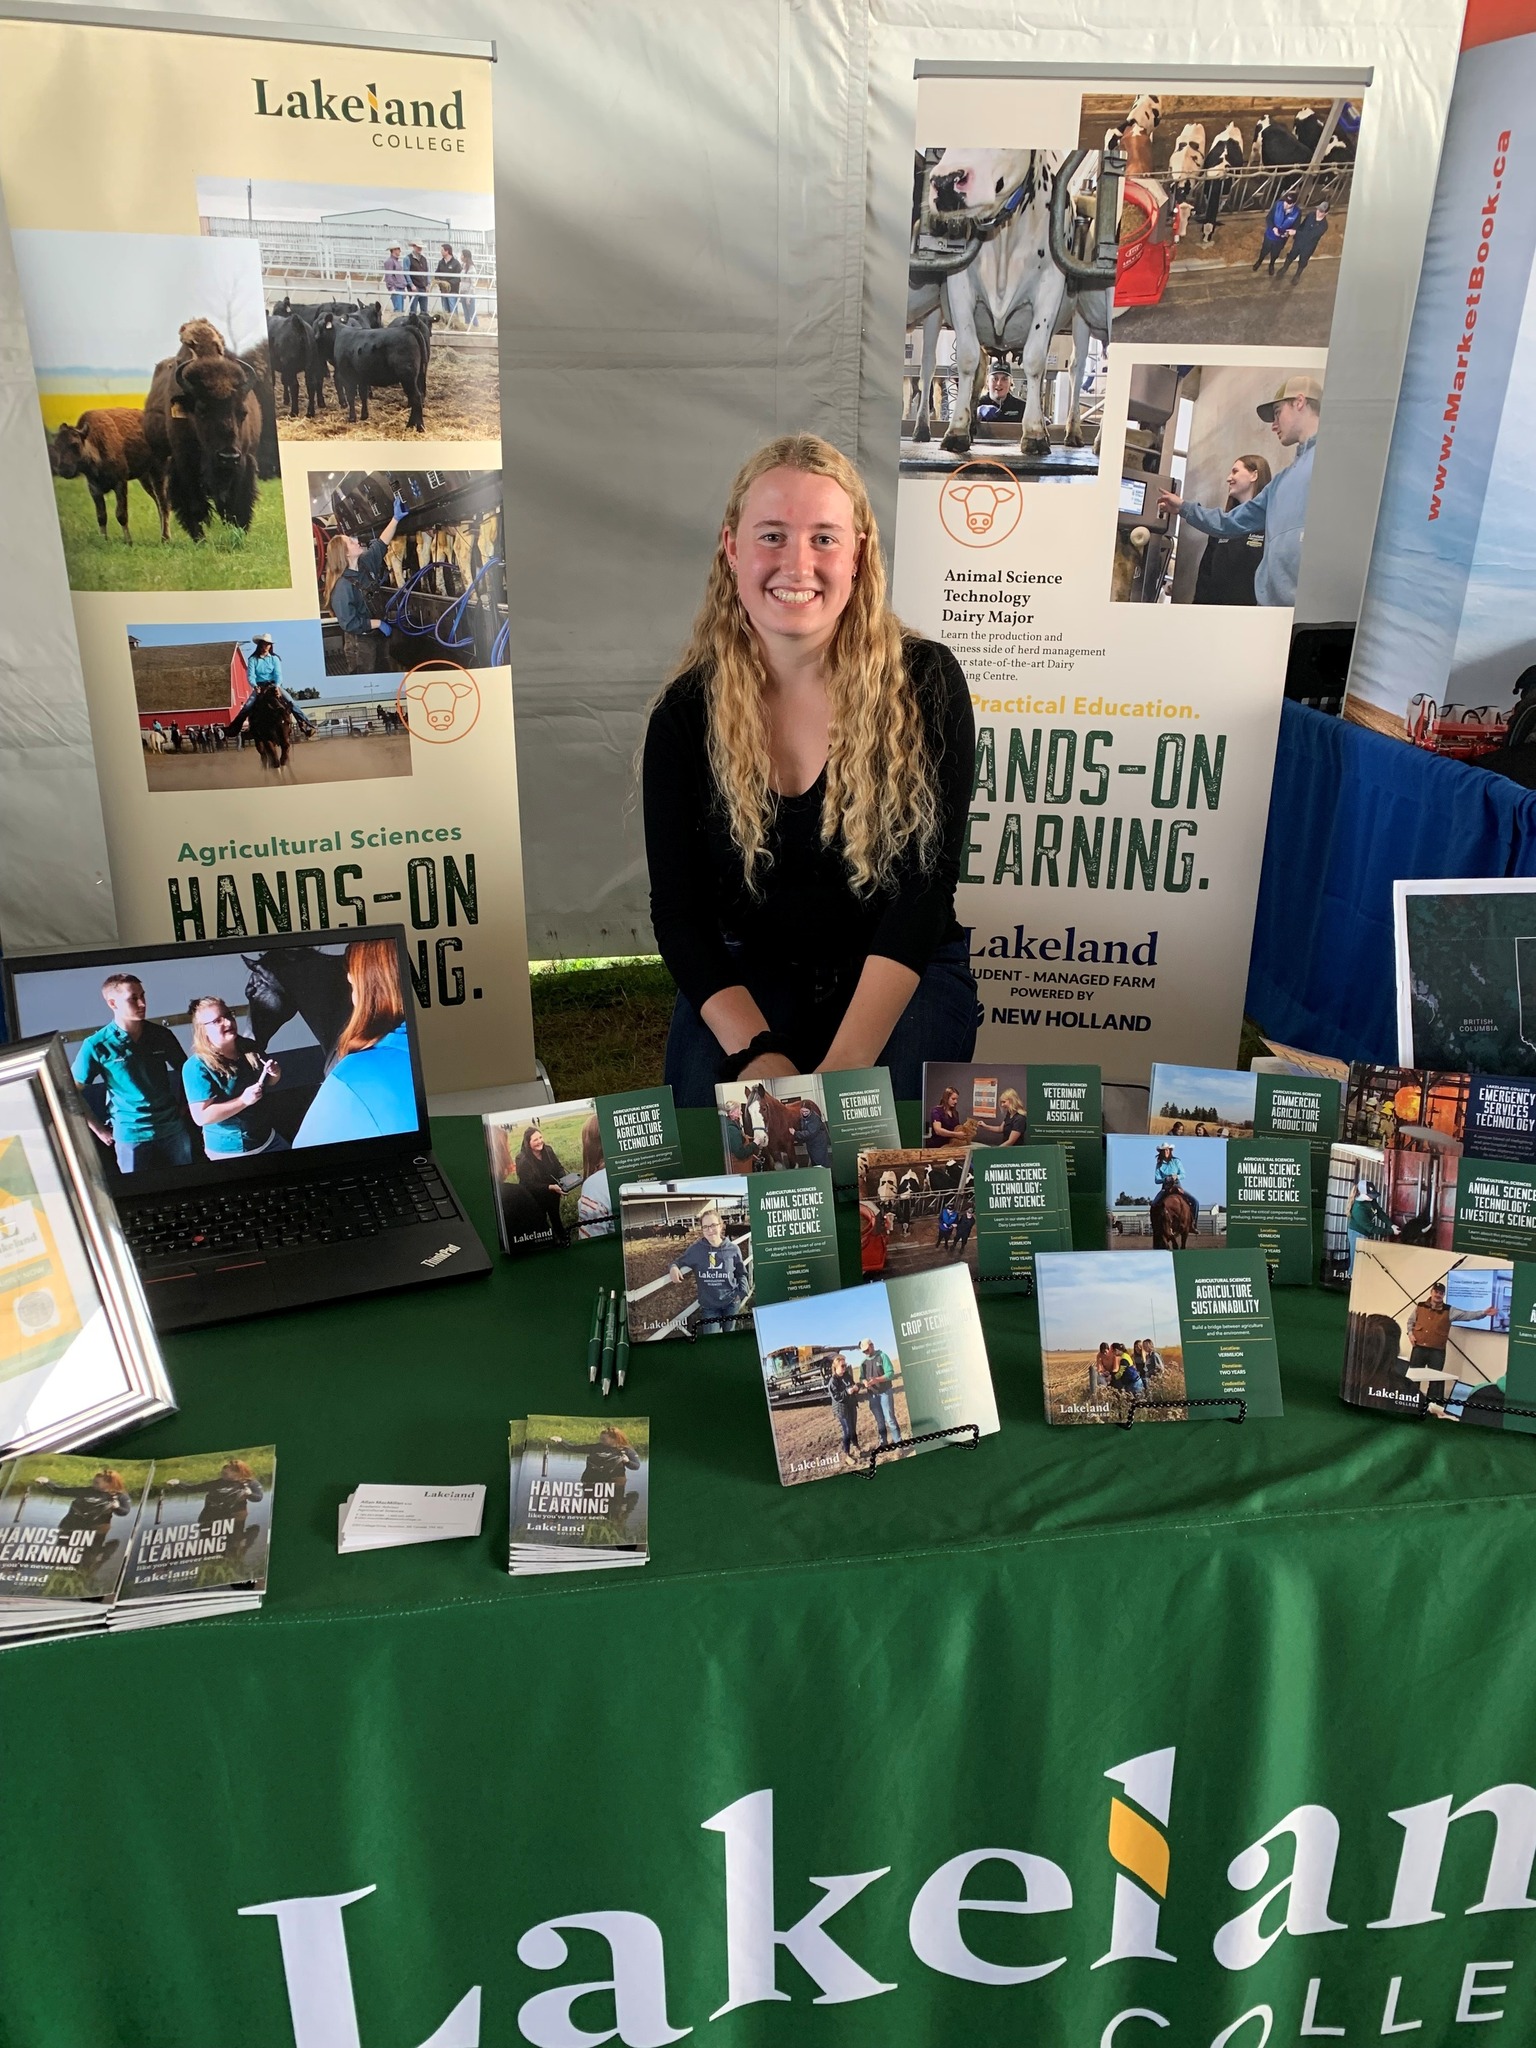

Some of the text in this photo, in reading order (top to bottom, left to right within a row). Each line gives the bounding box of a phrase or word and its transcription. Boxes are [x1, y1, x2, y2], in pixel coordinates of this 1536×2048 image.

[251, 78, 467, 131] Lakeland
[371, 133, 466, 154] COLLEGE
[1428, 129, 1512, 523] www.MarketBook.ca
[944, 569, 1062, 585] Animal Science
[943, 588, 1031, 607] Technology
[942, 609, 1035, 628] Dairy Major
[940, 630, 1063, 643] Learn the production and
[948, 643, 1106, 660] siness side of herd management
[969, 658, 1045, 669] state-of-the-art
[1047, 659, 1074, 671] Dairy
[983, 671, 1018, 682] Centre.
[970, 693, 1200, 719] Practical Education.
[970, 727, 1227, 810] ANDS-ON
[177, 826, 462, 867] Agricultural Sciences
[959, 812, 1209, 893] EARNING.
[167, 853, 479, 942] HANDS-ON
[963, 924, 1158, 967] Lakeland
[969, 968, 1023, 982] UDENT
[1033, 970, 1110, 986] MANAGED
[1112, 972, 1156, 989] FARM
[1010, 986, 1095, 1001] POWERED BY
[991, 1007, 1152, 1032] NEW HOLLAND
[1459, 1024, 1499, 1032] COLUMBIA
[840, 1094, 880, 1109] VETERINARY
[1043, 1088, 1086, 1099] VETERINARY
[1272, 1094, 1320, 1109] COMMERCIAL
[1479, 1087, 1536, 1106] EMERGENCY
[842, 1106, 882, 1121] TECHNOLOGY
[1050, 1099, 1080, 1110] MEDICAL
[1271, 1106, 1320, 1121] AGRICULTURE
[1483, 1101, 1529, 1118] SERVICES
[613, 1108, 661, 1128] BACHELOR OF
[1046, 1111, 1084, 1122] ASSISTANT
[1272, 1118, 1317, 1133] PRODUCTION
[1476, 1113, 1535, 1132] TECHNOLOGY
[617, 1121, 663, 1140] AGRICULTURE
[618, 1133, 663, 1152] TECHNOLOGY
[984, 1168, 1048, 1182] ANIMAL SCIENCE
[1237, 1162, 1301, 1176] ANIMAL SCIENCE
[991, 1181, 1043, 1195] TECHNOLOGY:
[1243, 1176, 1295, 1188] TECHNOLOGY:
[1467, 1181, 1536, 1201] ANIMAL SCIENCE
[760, 1192, 824, 1211] ANIMAL SCIENCE
[765, 1188, 797, 1197] AGRICULTURAL
[1238, 1189, 1300, 1202] EQUINE SCIENCE
[989, 1195, 1046, 1209] DAIRY SCIENCE
[1474, 1195, 1531, 1214] TECHNOLOGY:
[767, 1206, 819, 1224] TECHNOLOGY:
[1459, 1208, 1536, 1230] LIVESTOCK SCIENC
[513, 1227, 553, 1244] Lakeland
[767, 1219, 821, 1238] BEEF SCIENCE
[420, 1243, 462, 1268] ThinkPad
[698, 1271, 732, 1280] Lakelan
[1196, 1284, 1253, 1299] AGRICULTURE
[1191, 1299, 1260, 1315] SUSTAINABILITY
[901, 1319, 922, 1338] CROP
[1368, 1386, 1420, 1404] Lakeland
[1394, 1400, 1420, 1408] COLLEGE
[1060, 1402, 1110, 1414] Lakeland
[789, 1452, 840, 1474] Lakeland
[424, 1490, 475, 1499] Lakeland
[529, 1480, 616, 1499] HANDS-ON
[527, 1496, 610, 1514] LEARNING
[542, 1513, 566, 1521] you've
[140, 1517, 235, 1548] HANDS-ON
[526, 1522, 585, 1533] Lakeland
[0, 1526, 97, 1548] HANDS-ON
[0, 1544, 84, 1565] EARNING
[136, 1535, 228, 1566] LEARNING
[135, 1563, 152, 1572] like
[178, 1556, 202, 1566] never
[0, 1572, 49, 1584] keland
[133, 1565, 199, 1585] Lakeland
[237, 1744, 1536, 2048] Lakelan
[1100, 1961, 1514, 2048] COLLE
